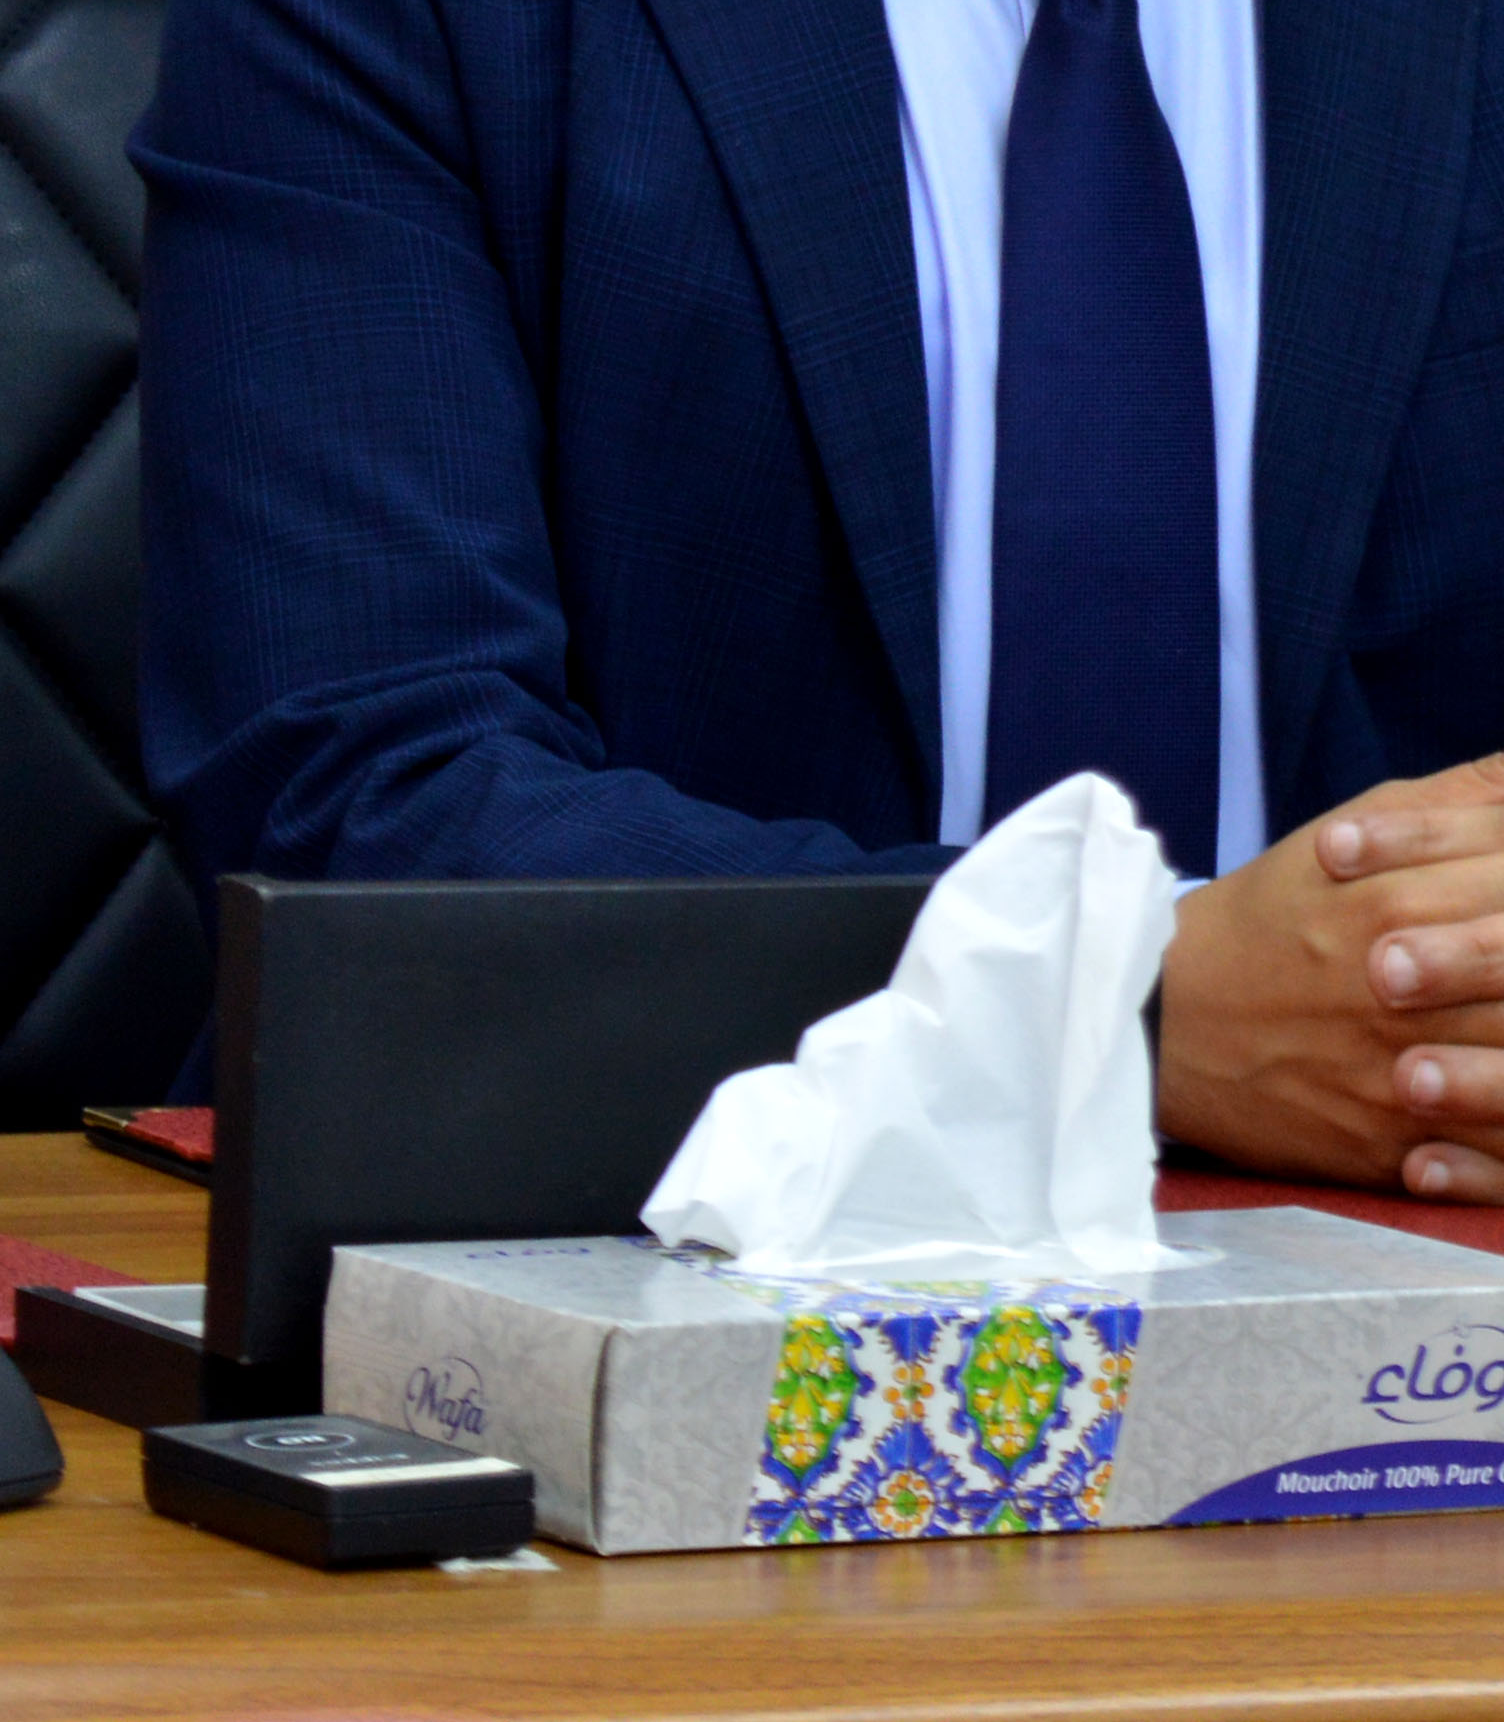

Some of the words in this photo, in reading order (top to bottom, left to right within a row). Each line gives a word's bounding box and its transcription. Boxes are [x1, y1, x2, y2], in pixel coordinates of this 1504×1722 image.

[407, 1366, 484, 1441] Wafa
[1276, 1468, 1378, 1494] Mouchoir
[1384, 1465, 1440, 1489] 100%
[1445, 1463, 1494, 1486] Pure
